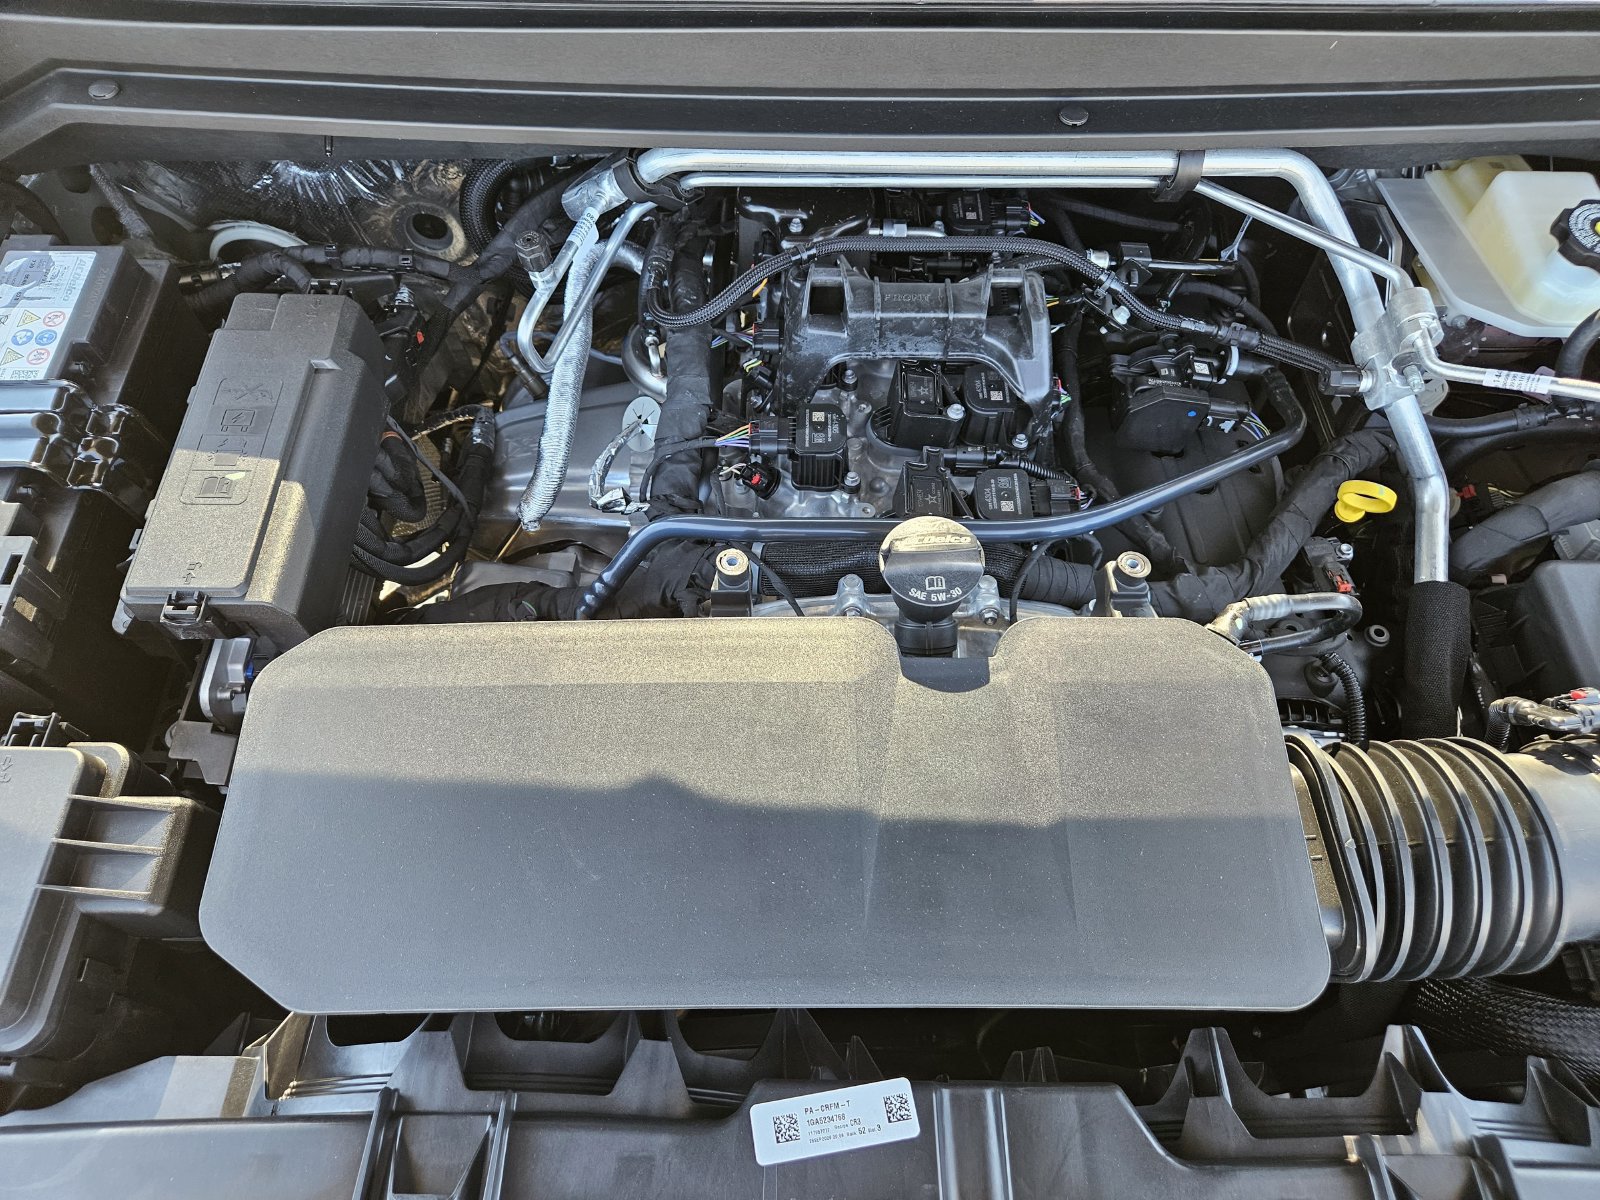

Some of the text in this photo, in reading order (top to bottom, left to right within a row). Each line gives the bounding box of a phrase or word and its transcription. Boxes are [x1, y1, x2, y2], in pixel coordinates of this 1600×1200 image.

[909, 586, 963, 601] SAE 5W-30
[858, 1127, 867, 1135] 52
[877, 1124, 882, 1132] 3
